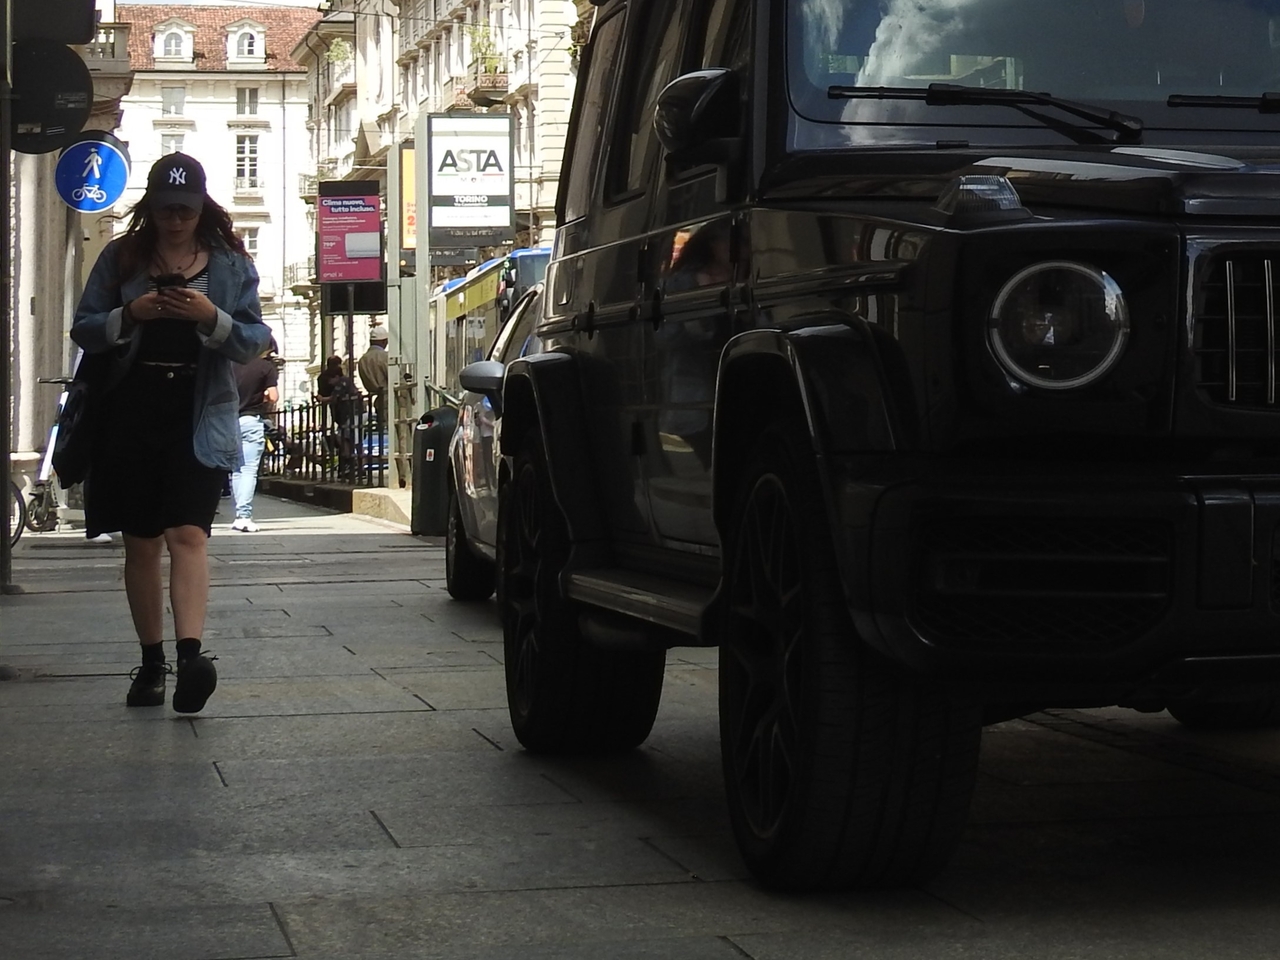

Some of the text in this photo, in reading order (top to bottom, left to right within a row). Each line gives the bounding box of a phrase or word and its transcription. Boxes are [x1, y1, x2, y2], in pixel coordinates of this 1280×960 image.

[437, 149, 504, 173] ASTA
[168, 167, 187, 185] NY
[453, 195, 488, 203] TORINO
